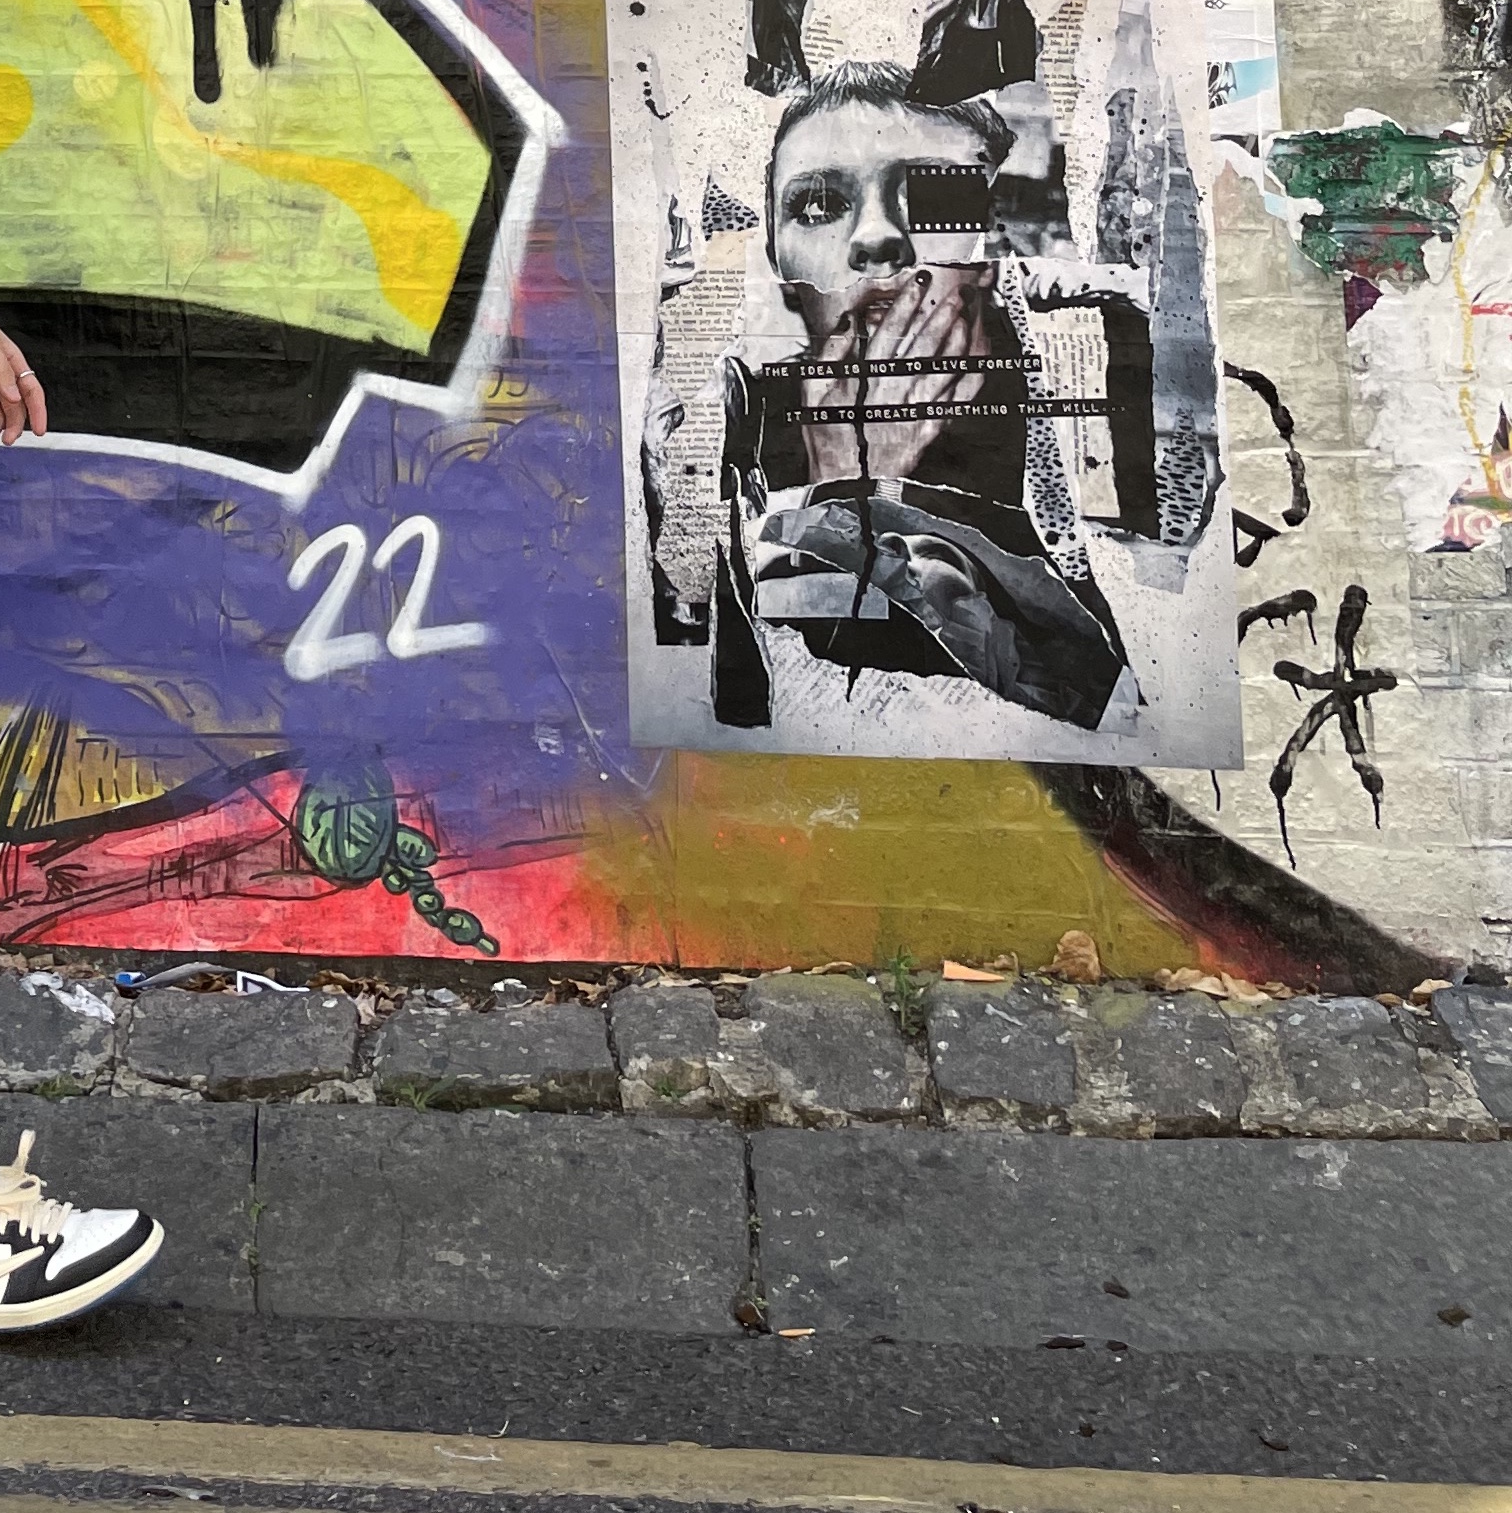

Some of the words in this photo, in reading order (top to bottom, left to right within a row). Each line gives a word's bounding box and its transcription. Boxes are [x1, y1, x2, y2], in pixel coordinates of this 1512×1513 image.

[764, 366, 789, 377] THE
[800, 364, 834, 377] IDEA
[844, 363, 860, 375] IS
[869, 362, 896, 374] NOT
[905, 361, 922, 372] TO
[932, 359, 968, 371] LIVE
[978, 357, 1042, 370] FOREVER
[786, 411, 801, 422] IT
[813, 410, 828, 421] IS
[838, 409, 855, 420] TO
[865, 407, 918, 420] CREATE
[926, 404, 1008, 416] SOMETHING
[1017, 403, 1054, 414] THAT
[283, 514, 488, 682] 22
